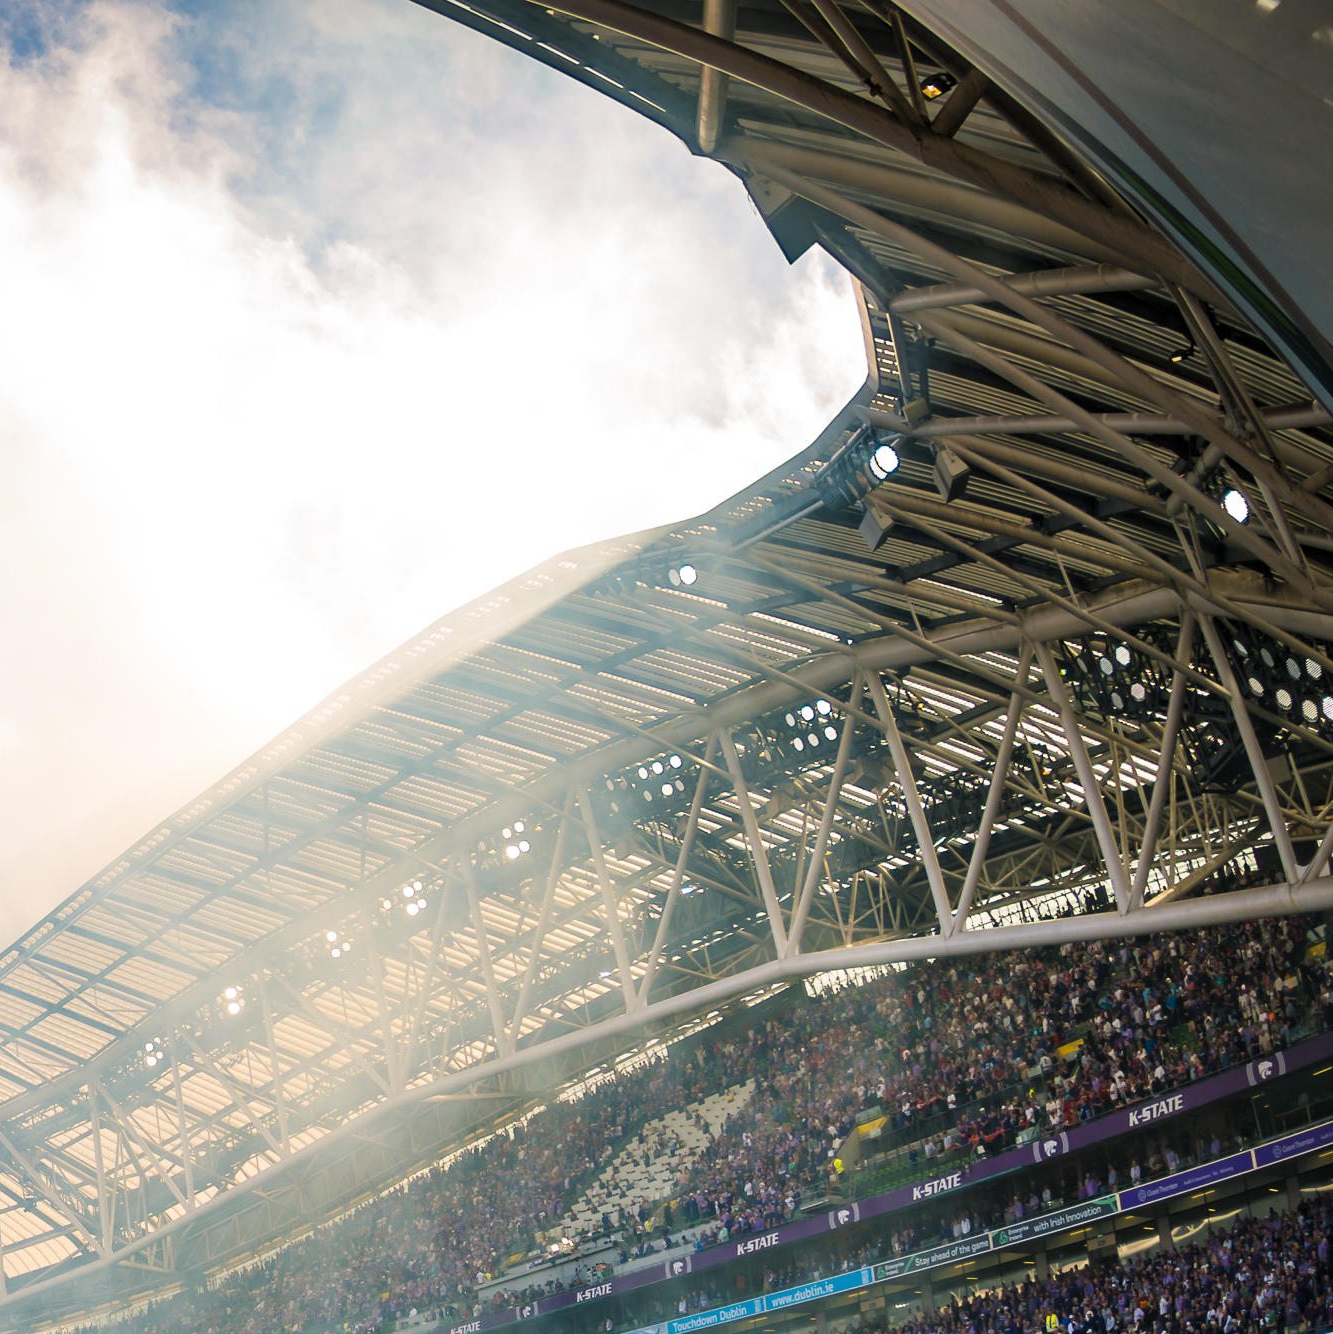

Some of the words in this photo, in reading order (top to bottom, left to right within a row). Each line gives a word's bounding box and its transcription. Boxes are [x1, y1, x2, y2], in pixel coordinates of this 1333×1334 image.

[1129, 1094, 1184, 1127] K-STATE
[1295, 1137, 1315, 1149] Thornton
[913, 1173, 962, 1200] K-STATE
[1159, 1182, 1178, 1194] Thornton
[1008, 1226, 1029, 1236] Enterprise
[1034, 1221, 1049, 1233] with
[1050, 1217, 1065, 1229] Irish
[1065, 1206, 1102, 1225] Innovation
[737, 1232, 779, 1256] K-STATE
[1009, 1233, 1023, 1242] Ireland
[914, 1256, 930, 1267] Stay
[931, 1250, 950, 1263] ahead
[951, 1247, 958, 1257] of
[959, 1244, 971, 1255] the
[971, 1240, 989, 1254] game
[577, 1283, 612, 1302] K-STATE
[771, 1282, 834, 1307] www.dublin.ie
[672, 1314, 718, 1333] Touchdown
[720, 1305, 747, 1321] Dublin
